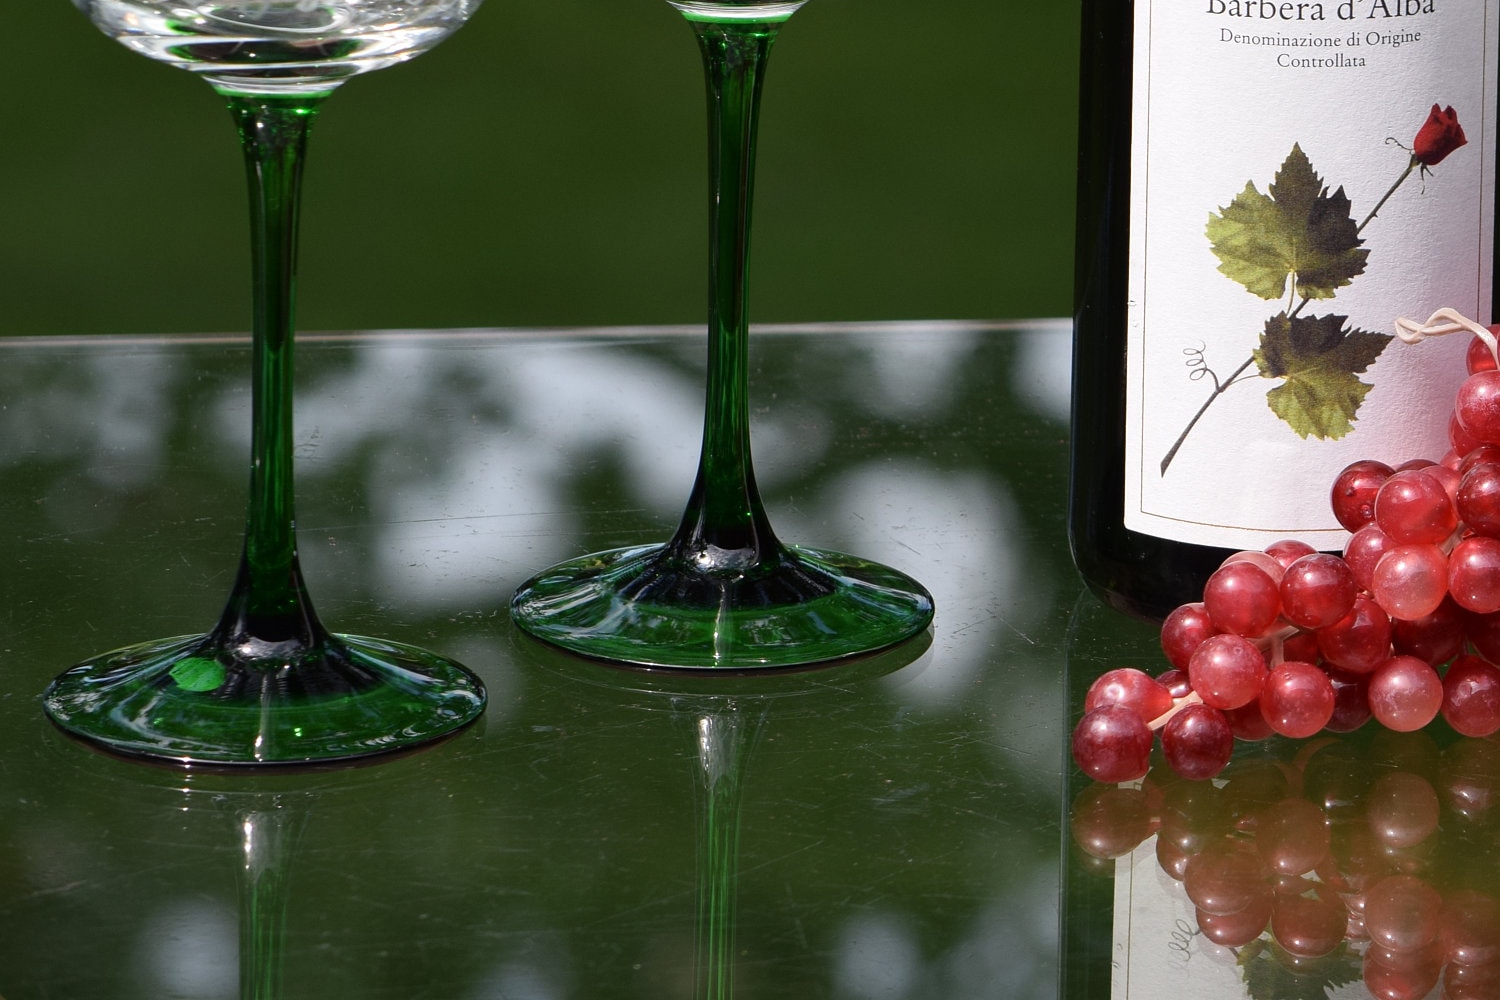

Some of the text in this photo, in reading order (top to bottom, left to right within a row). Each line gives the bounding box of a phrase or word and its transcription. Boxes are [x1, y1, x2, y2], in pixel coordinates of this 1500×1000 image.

[1219, 27, 1422, 48] Denominazione di Origine
[1276, 53, 1366, 68] Controllata
